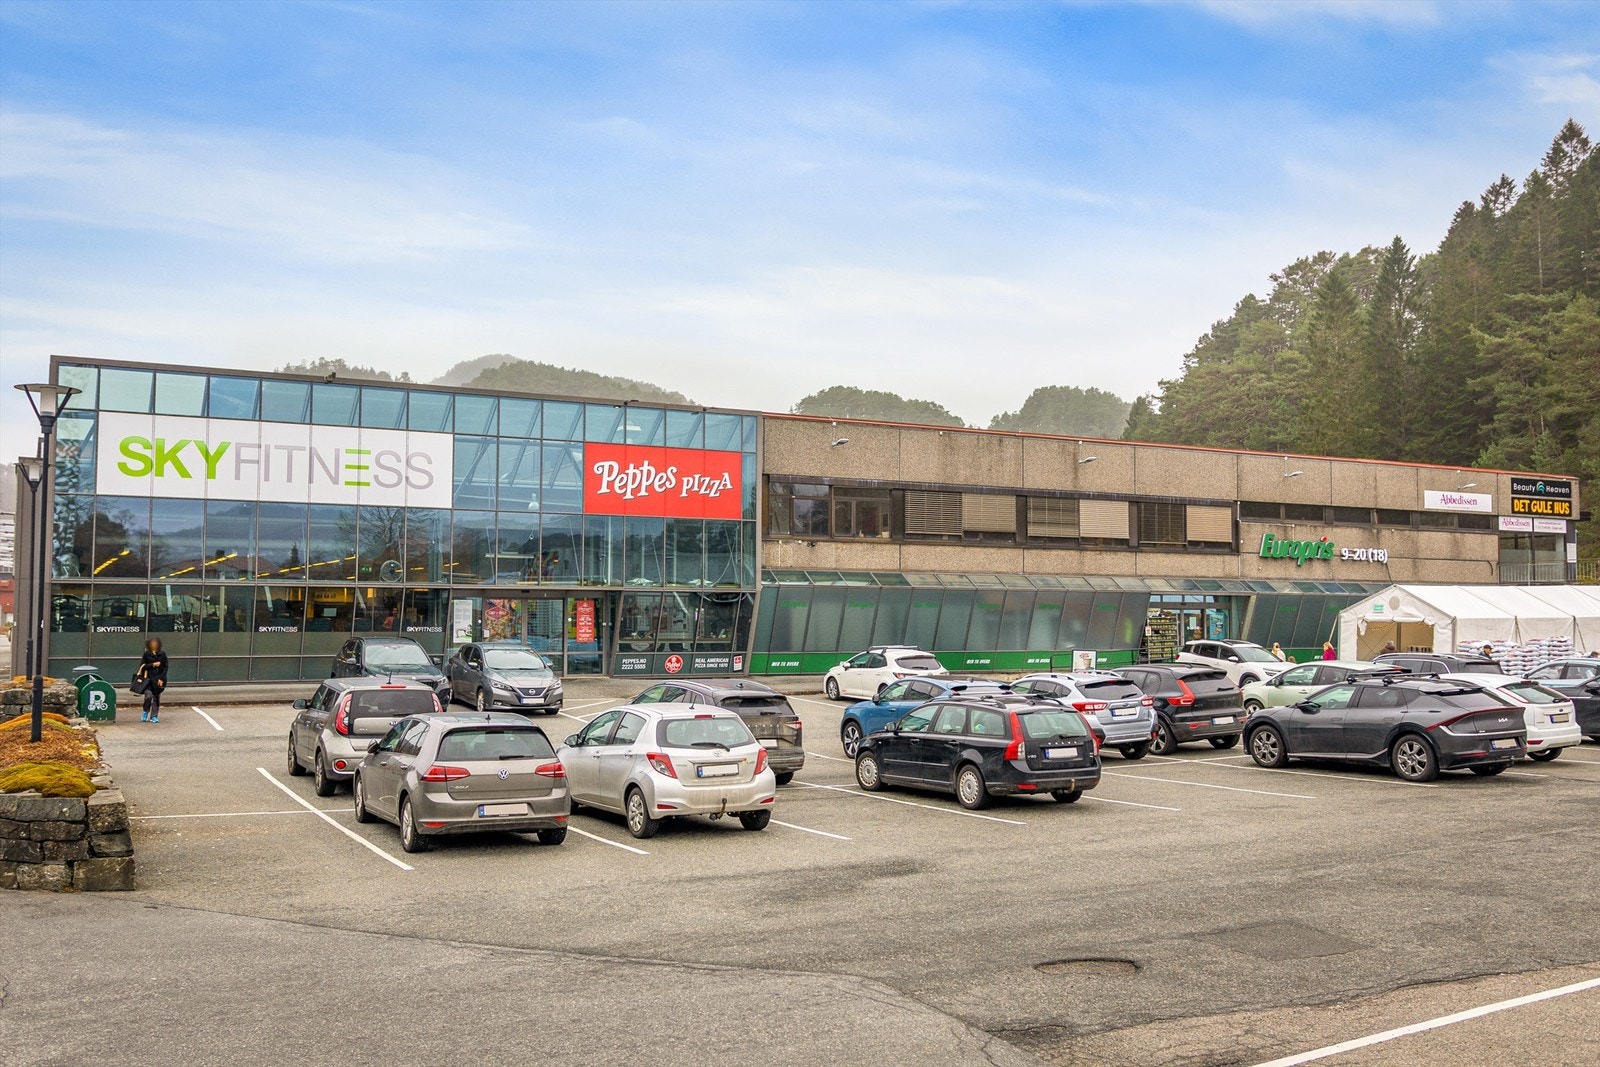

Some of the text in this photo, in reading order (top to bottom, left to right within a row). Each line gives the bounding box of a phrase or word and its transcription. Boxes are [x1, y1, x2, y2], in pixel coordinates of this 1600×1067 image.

[117, 436, 434, 490] SKYFITNESS
[593, 460, 678, 500] Peppes
[1513, 482, 1570, 494] Beauty Heaven
[1440, 494, 1477, 506] Abbedissen
[1513, 499, 1570, 515] DET GULE HUS
[1502, 517, 1530, 527] Abbedissen
[1259, 533, 1335, 566] Europris
[1368, 547, 1388, 563] (18)
